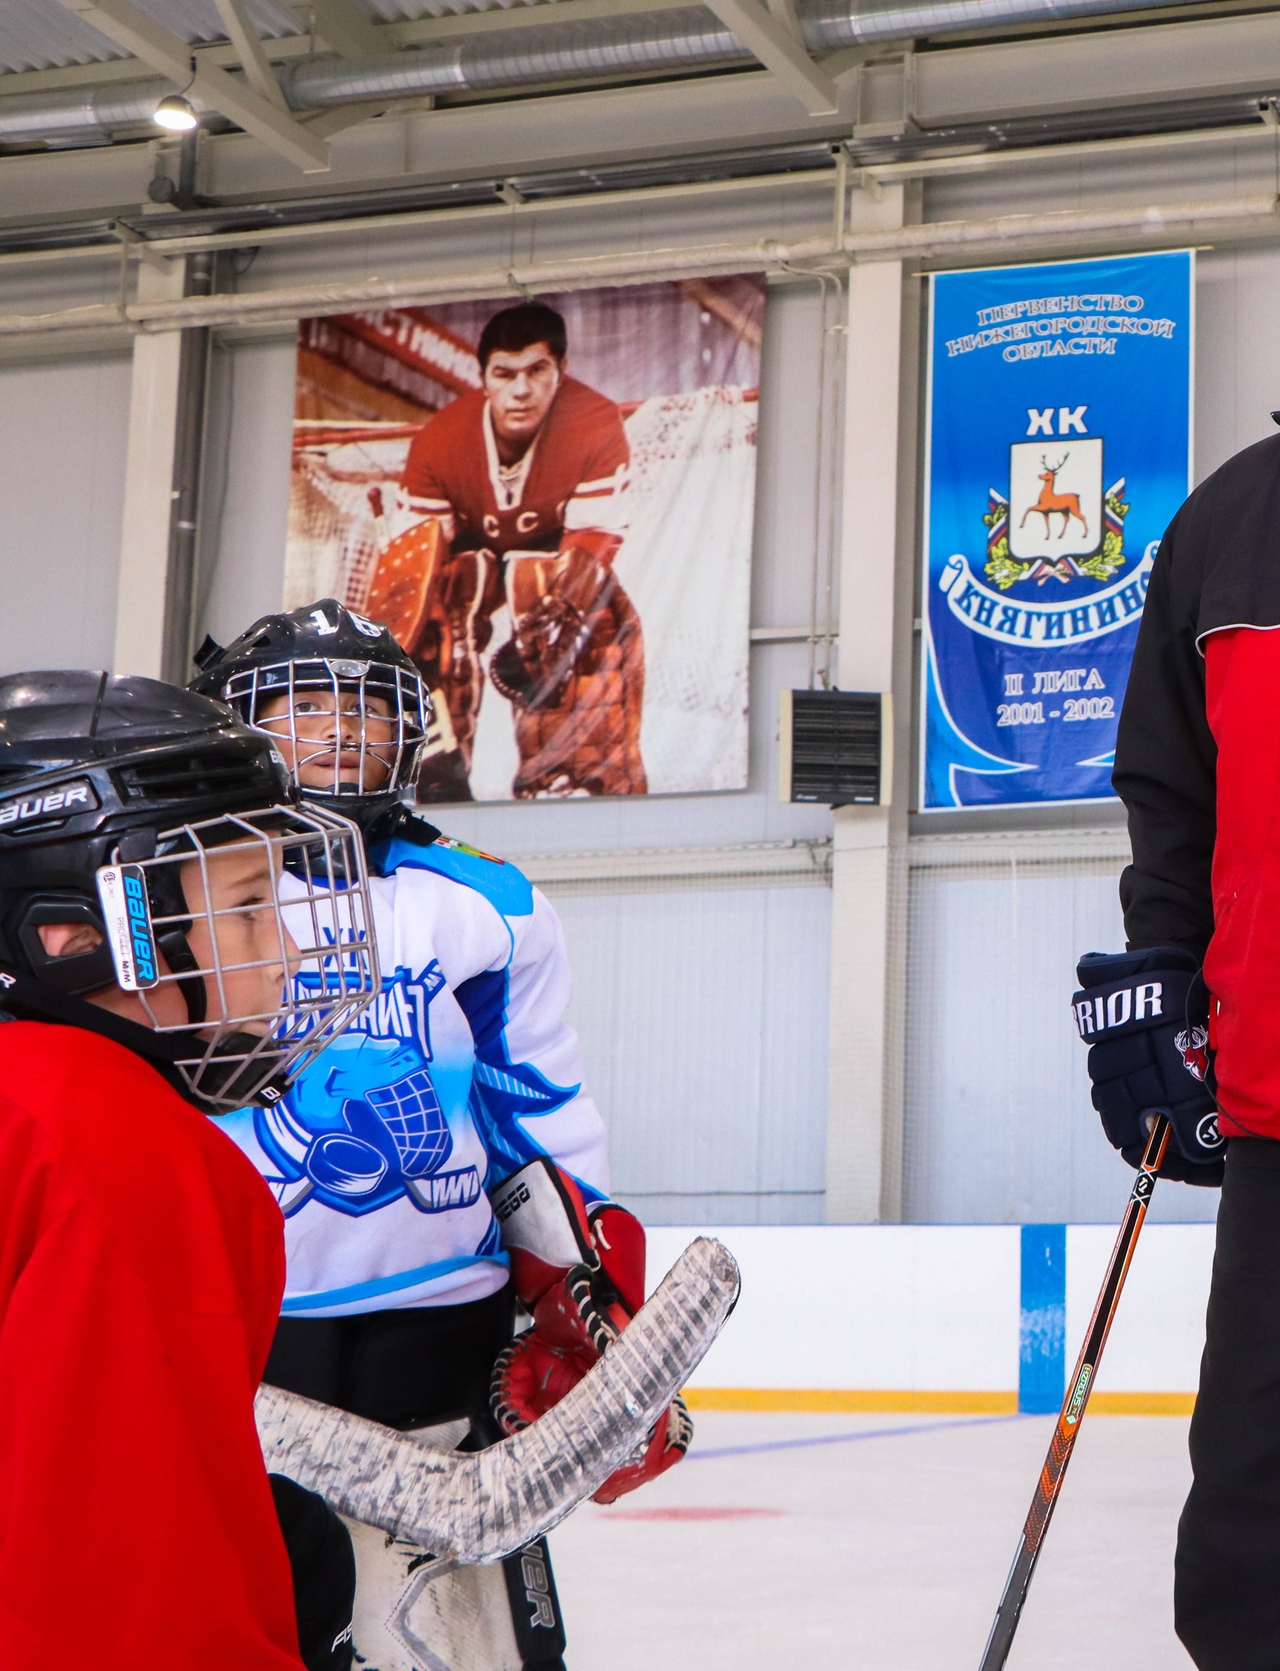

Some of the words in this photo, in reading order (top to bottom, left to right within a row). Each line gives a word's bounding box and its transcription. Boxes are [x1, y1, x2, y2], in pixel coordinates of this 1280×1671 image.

[977, 294, 1144, 326] ПЕРВЕНСТВО
[946, 316, 1176, 357] НИЖЕГОРОДСКОЙ
[1003, 338, 1117, 363] ОБЛАСТИ
[1026, 405, 1088, 436] ХК
[1032, 668, 1105, 695] ЛИГА
[997, 702, 1045, 727] 2001
[1064, 697, 1115, 721] 2002
[0, 786, 88, 825] AUER
[123, 875, 156, 981] BAUER
[1072, 982, 1163, 1036] RIOR
